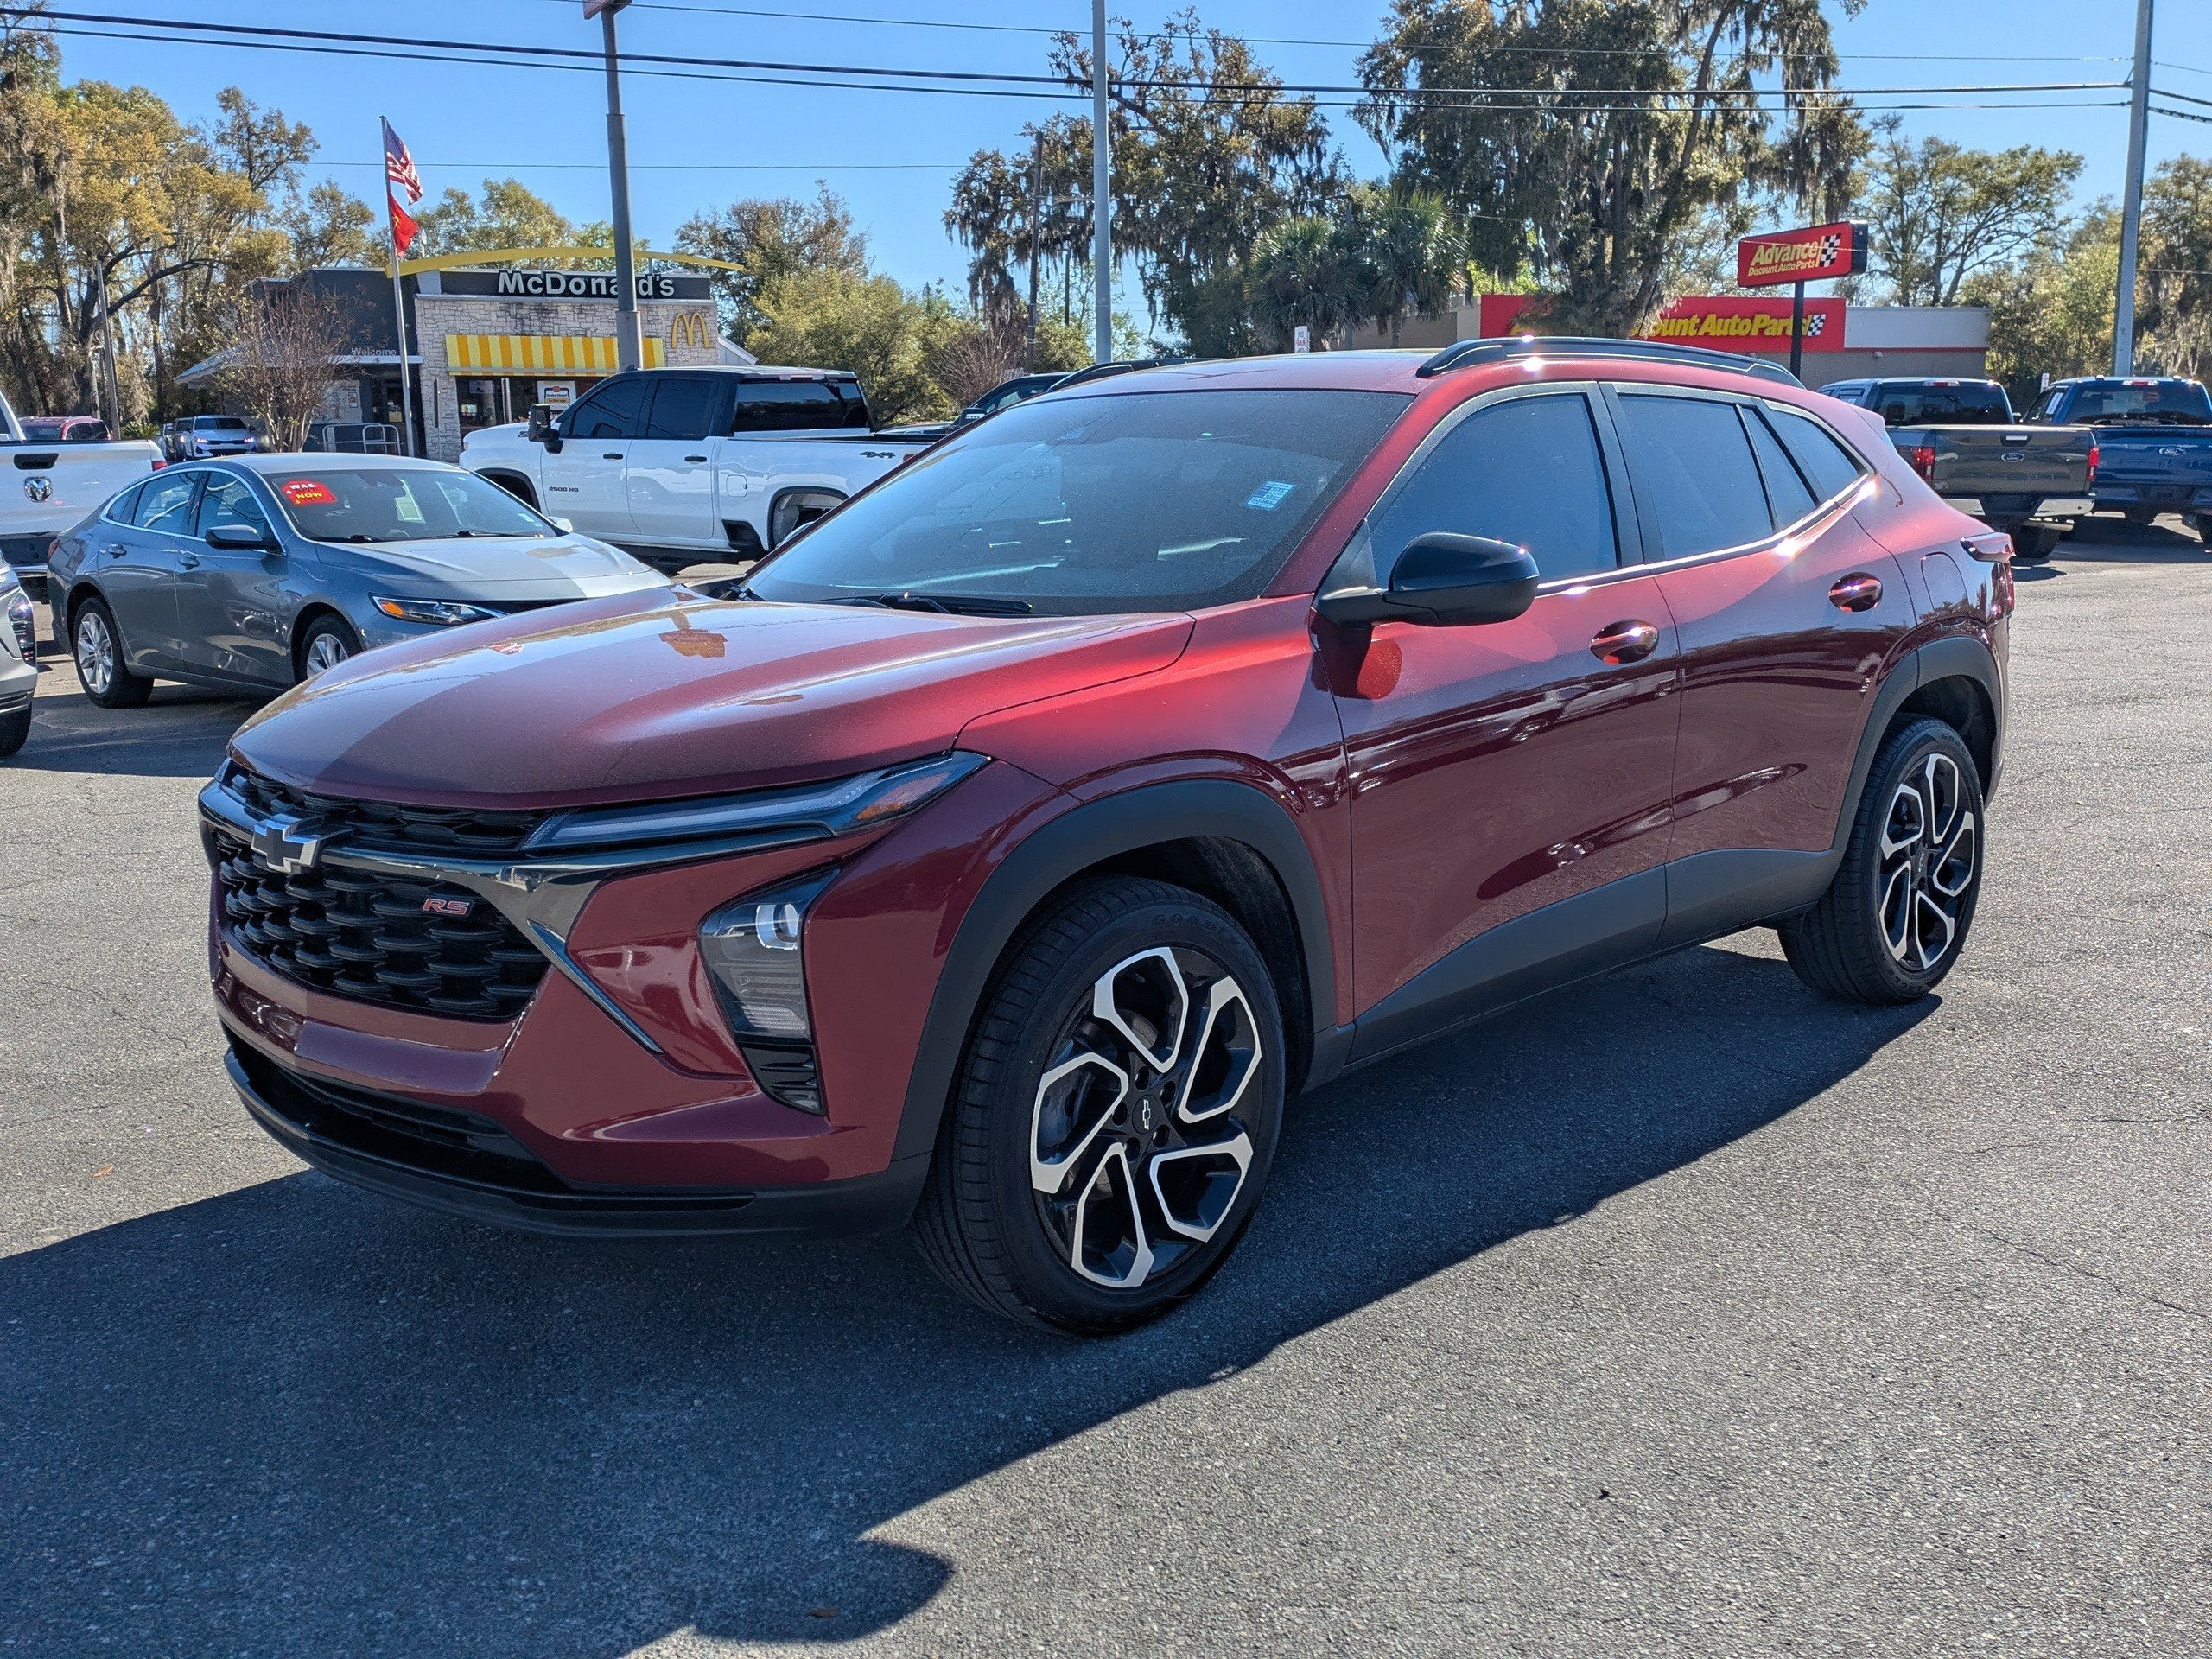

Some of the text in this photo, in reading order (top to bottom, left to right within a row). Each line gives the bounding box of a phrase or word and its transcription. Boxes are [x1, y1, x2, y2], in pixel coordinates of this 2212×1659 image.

[1751, 241, 1819, 266] Advance
[1748, 258, 1815, 276] Discount Auto Parts
[498, 271, 675, 296] McDonad's
[351, 347, 397, 356] Welcome
[423, 898, 470, 915] RS
